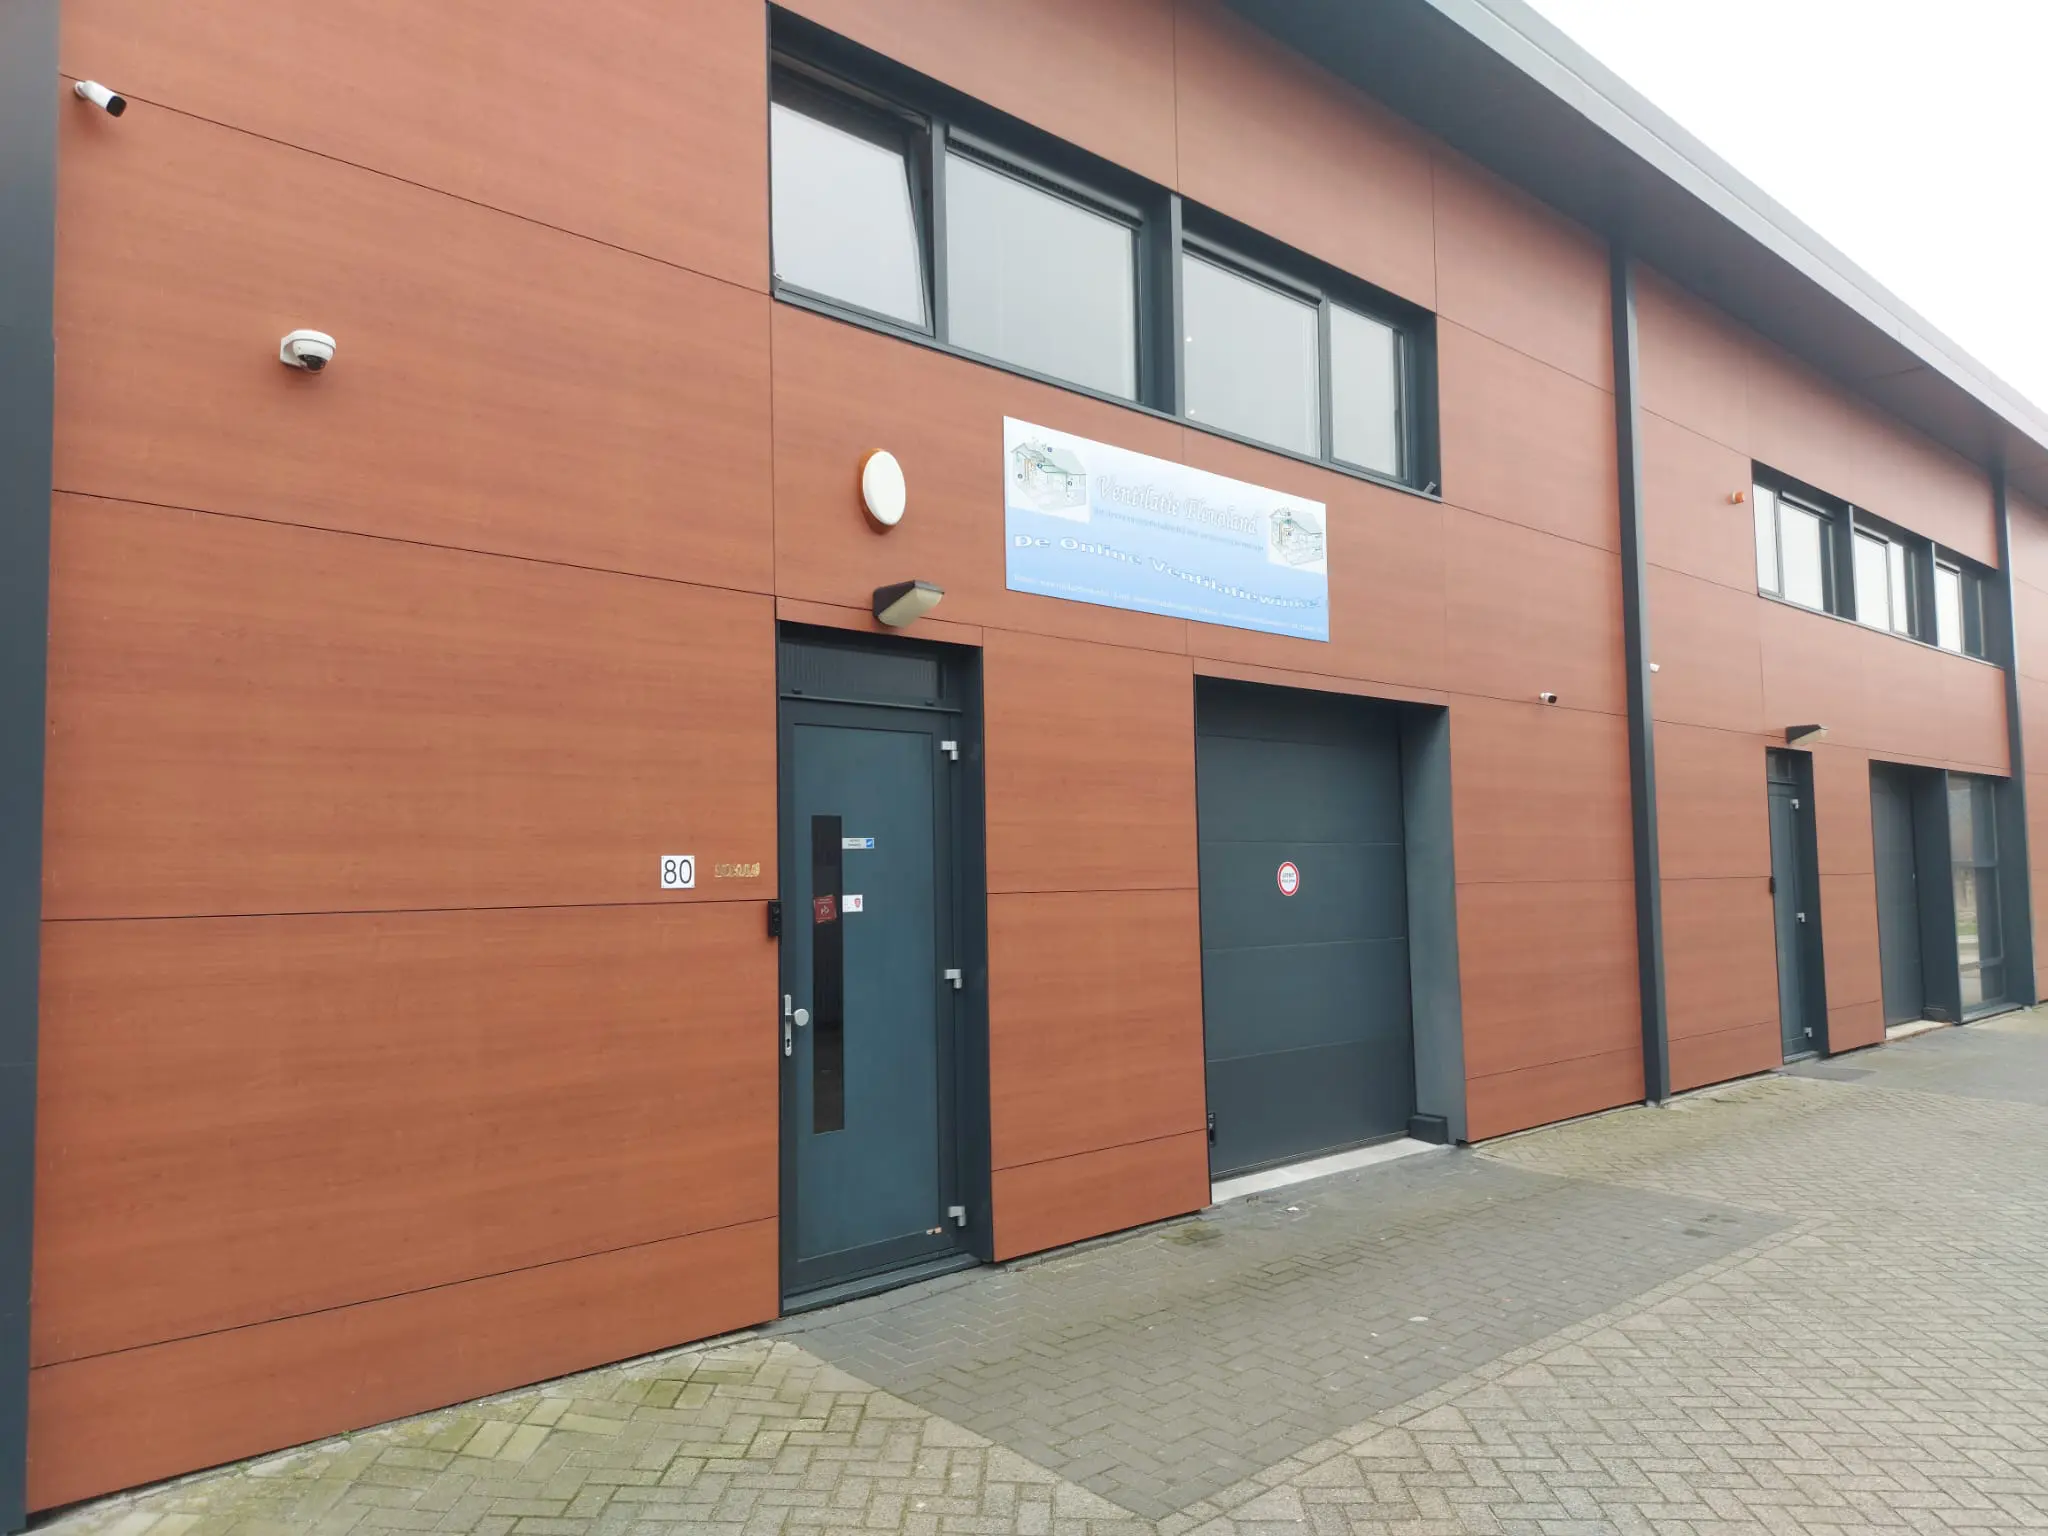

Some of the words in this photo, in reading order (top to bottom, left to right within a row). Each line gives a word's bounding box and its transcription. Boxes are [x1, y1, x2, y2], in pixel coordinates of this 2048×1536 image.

[1014, 533, 1051, 549] De
[1060, 536, 1143, 566] Online
[664, 859, 692, 884] 80
